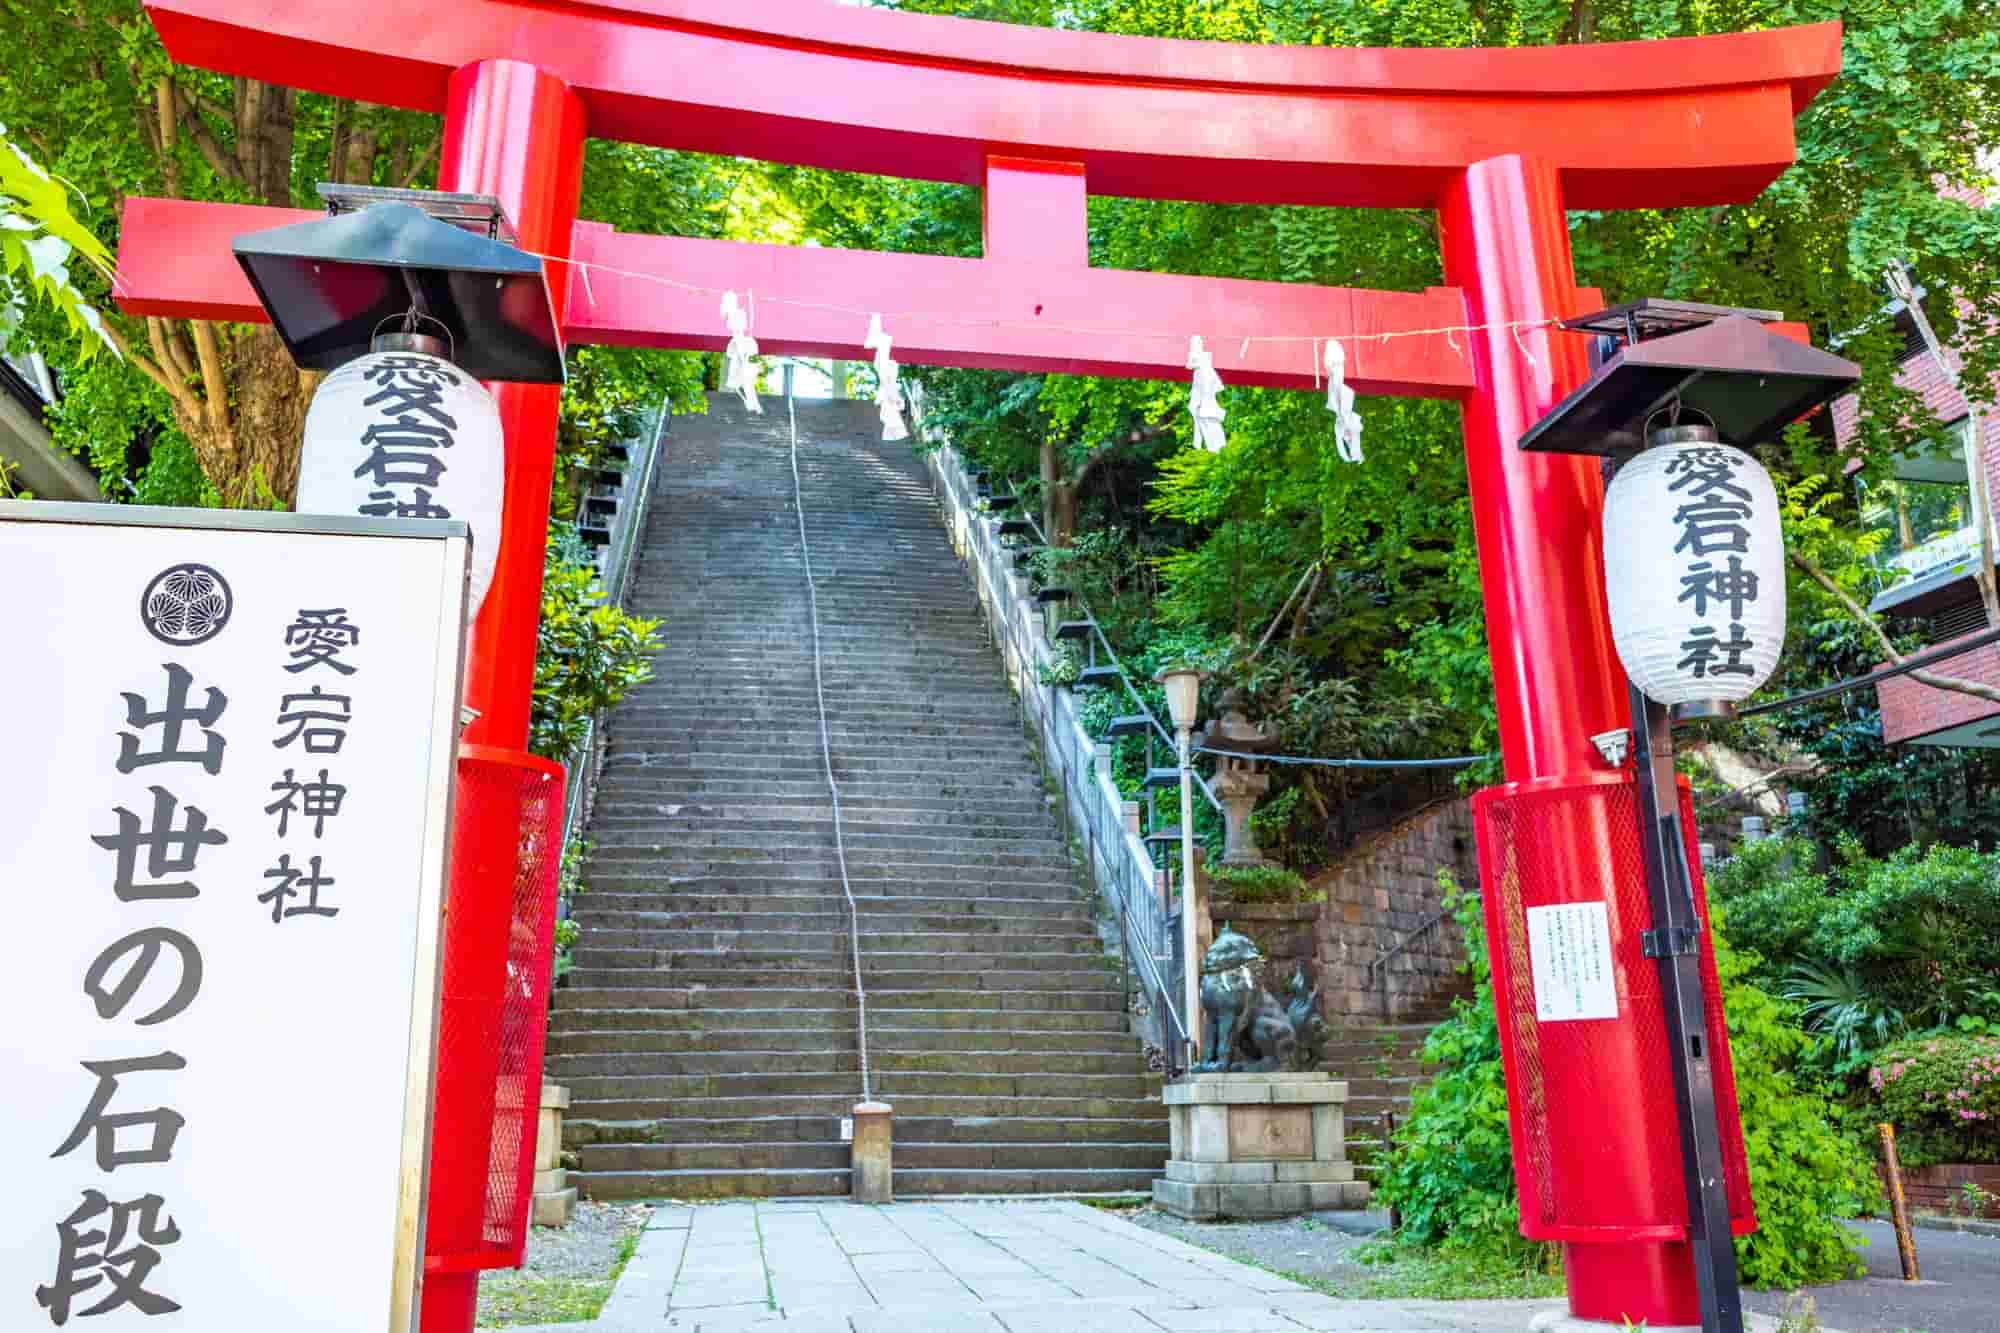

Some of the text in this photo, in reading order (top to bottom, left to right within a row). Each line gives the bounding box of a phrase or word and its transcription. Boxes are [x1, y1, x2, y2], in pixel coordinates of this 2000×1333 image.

[1665, 447, 1759, 678] 愛宕神社
[257, 607, 360, 924] 愛宕神社
[35, 662, 229, 1327] 出世の石段
